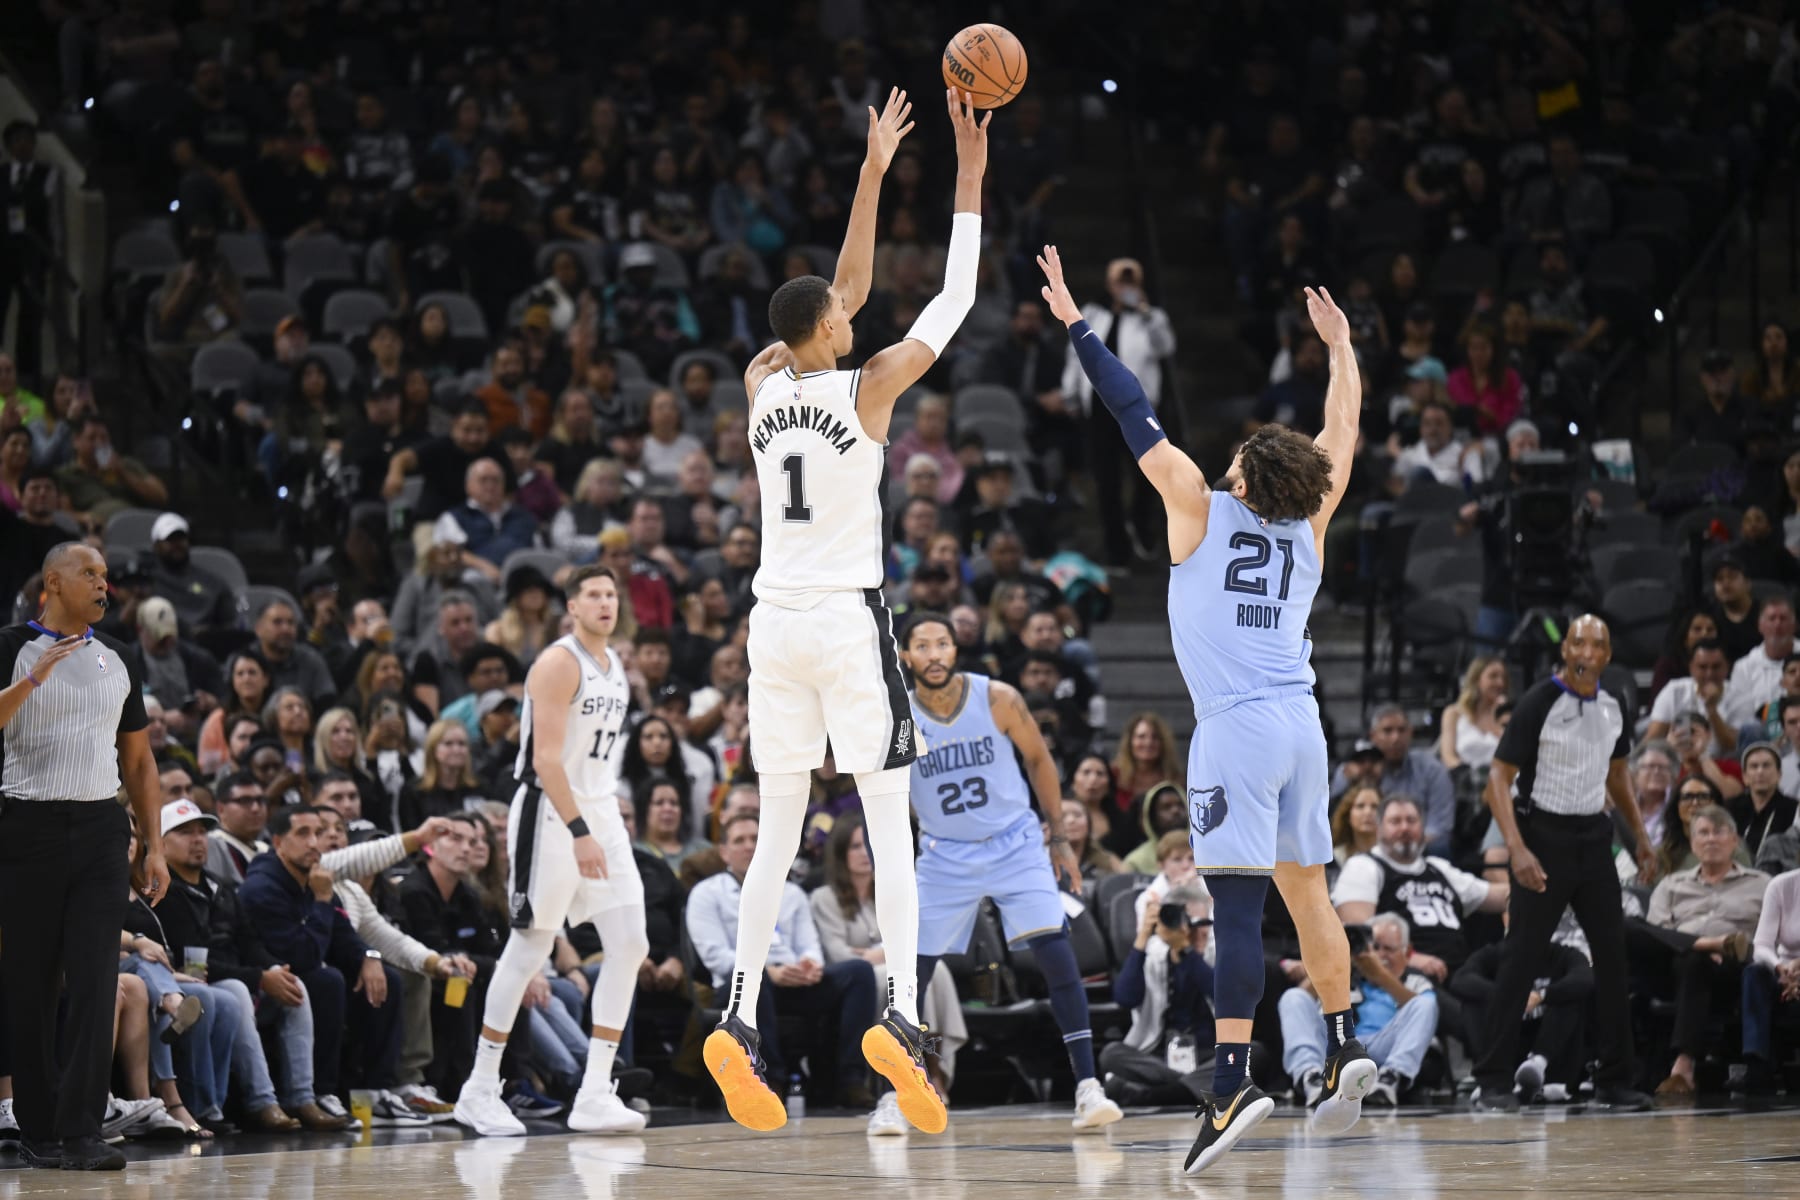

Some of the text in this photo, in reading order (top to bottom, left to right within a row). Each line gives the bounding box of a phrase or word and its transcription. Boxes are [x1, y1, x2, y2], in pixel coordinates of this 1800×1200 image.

[753, 405, 857, 455] WEMBANYAMA
[781, 452, 813, 524] 1
[1224, 531, 1295, 600] 21
[1236, 603, 1282, 629] RODDY
[589, 729, 617, 761] 17
[917, 736, 994, 778] GRIZZLIES
[937, 776, 989, 816] 23
